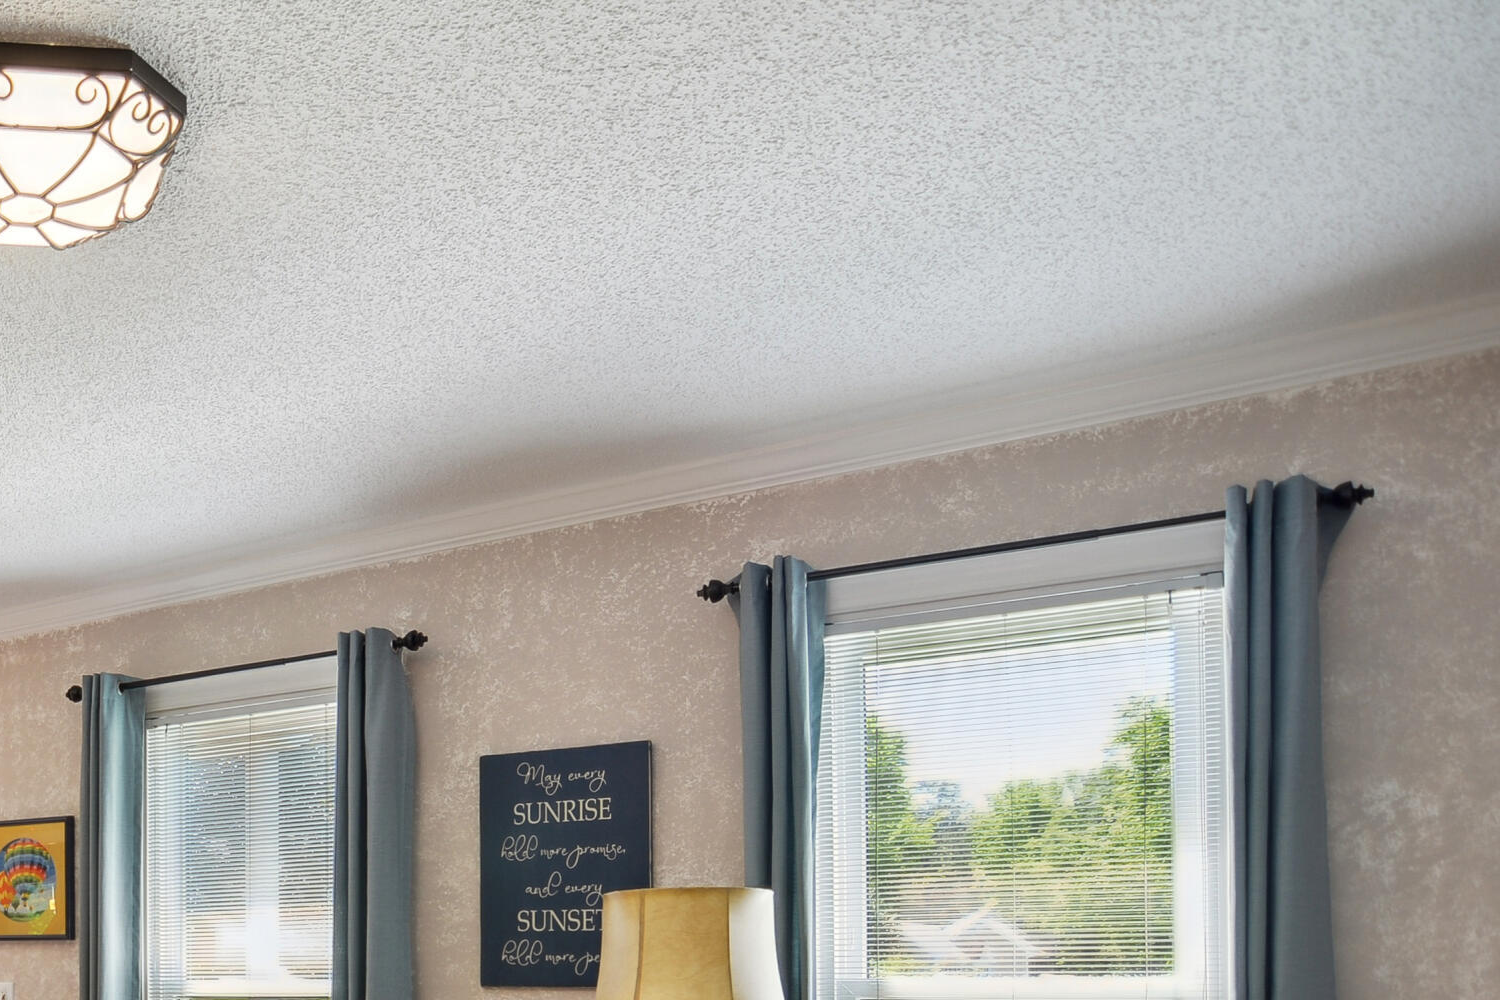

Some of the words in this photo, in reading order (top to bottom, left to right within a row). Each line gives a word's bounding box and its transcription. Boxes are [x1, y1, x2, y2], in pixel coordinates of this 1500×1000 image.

[516, 761, 563, 796] May
[567, 768, 607, 793] every
[513, 797, 613, 826] SUNRISE
[501, 834, 539, 862] hold
[540, 847, 568, 860] more
[525, 871, 563, 897] and
[564, 883, 605, 907] every
[501, 939, 543, 967] hold
[545, 952, 577, 965] more
